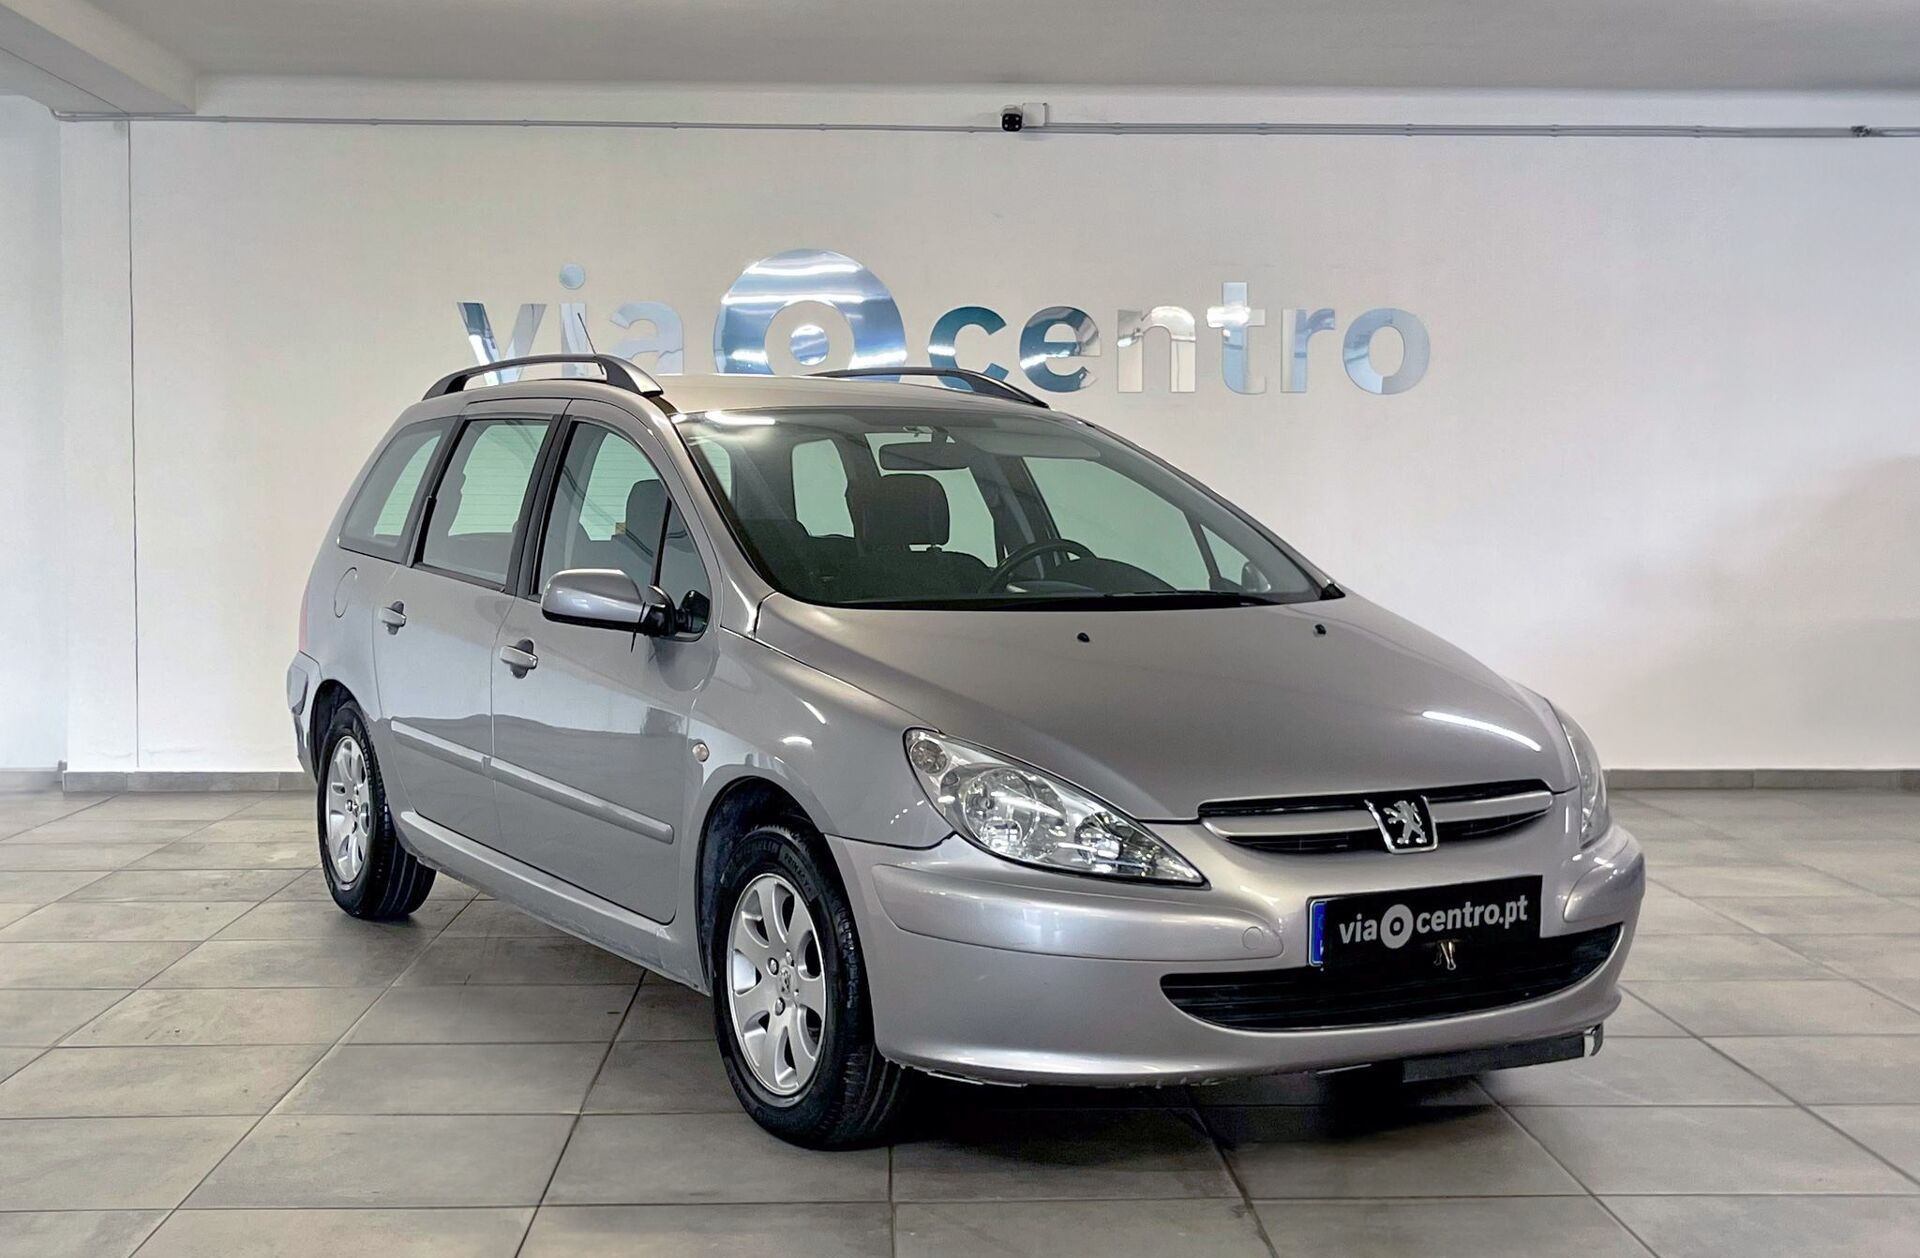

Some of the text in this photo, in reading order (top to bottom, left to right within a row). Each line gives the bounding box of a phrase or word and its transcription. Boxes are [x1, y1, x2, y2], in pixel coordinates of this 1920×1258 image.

[457, 263, 1430, 395] via centro
[1338, 895, 1529, 944] via centro.pt
